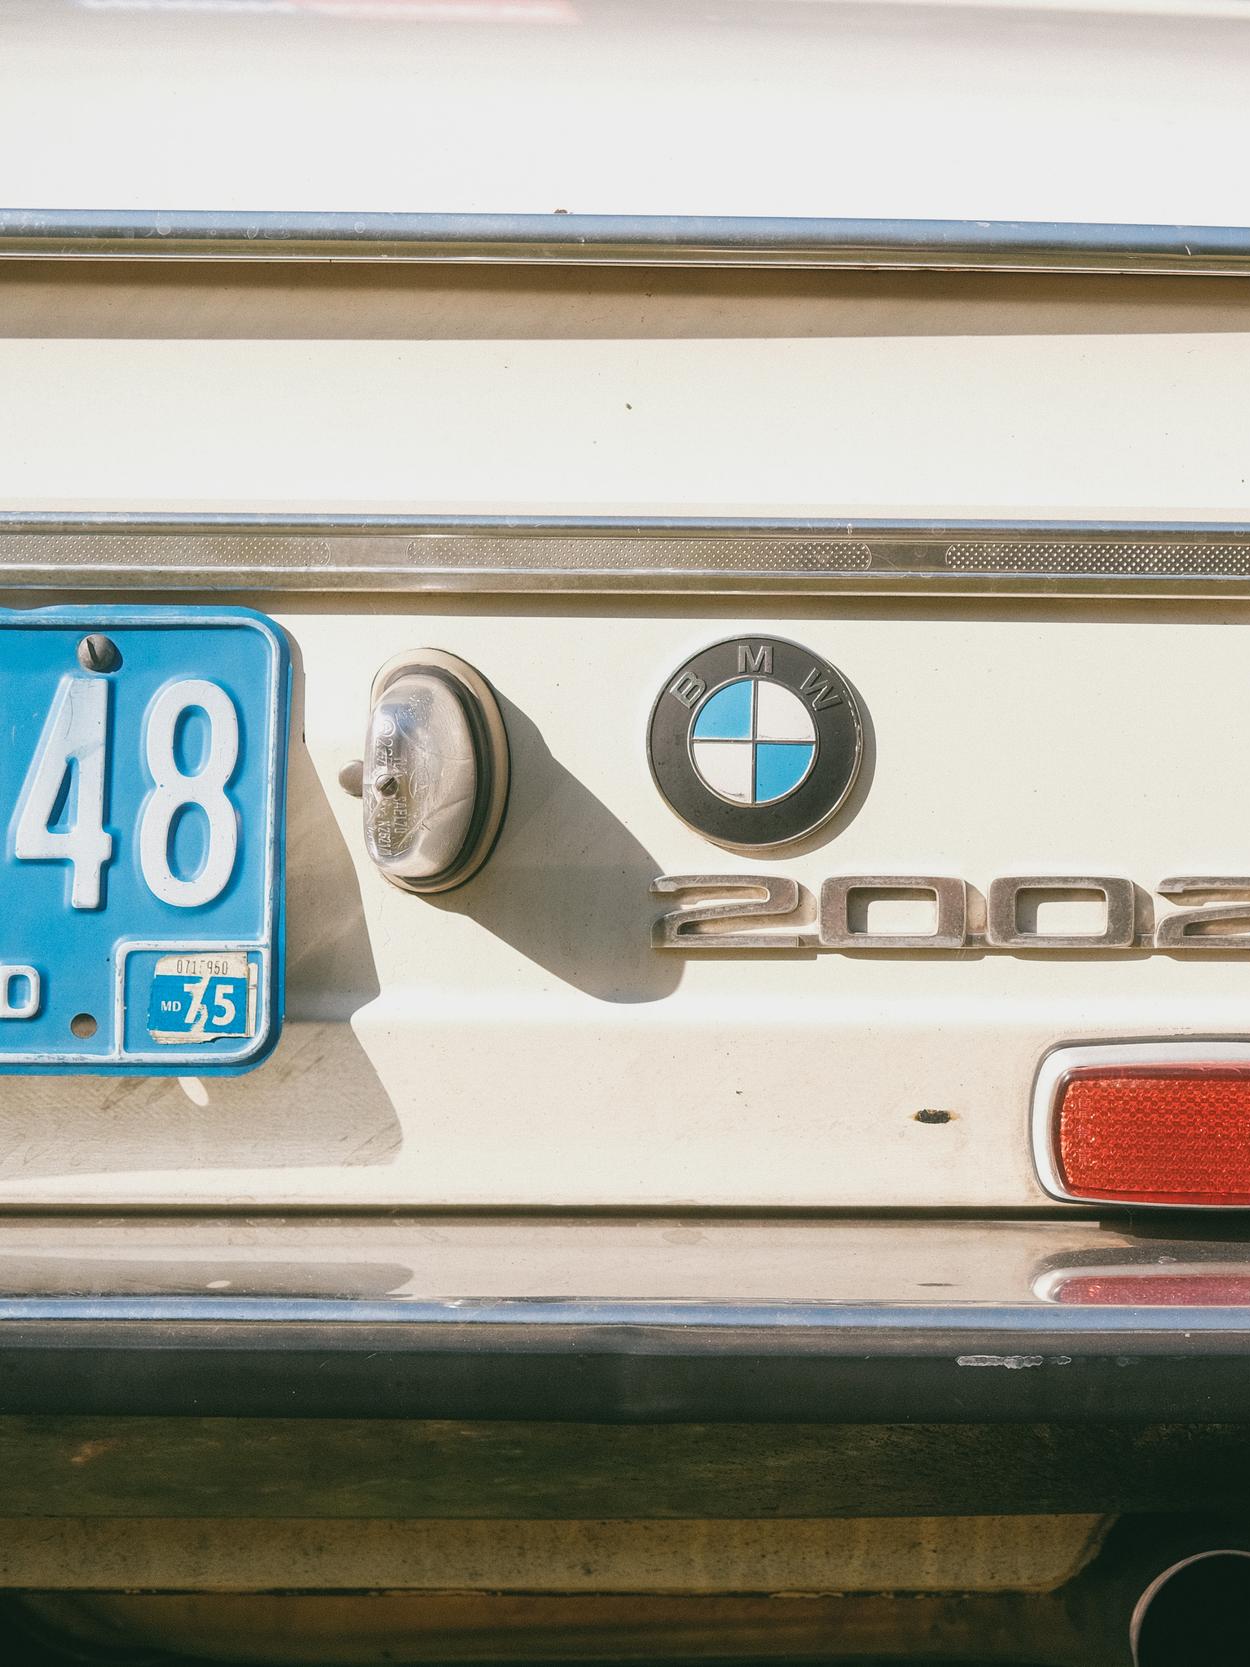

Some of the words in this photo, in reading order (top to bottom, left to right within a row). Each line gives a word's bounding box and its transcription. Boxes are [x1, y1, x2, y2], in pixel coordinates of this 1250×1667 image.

[668, 644, 842, 711] BMW
[15, 676, 240, 908] 48
[161, 1000, 181, 1011] MD
[184, 982, 236, 1026] 75
